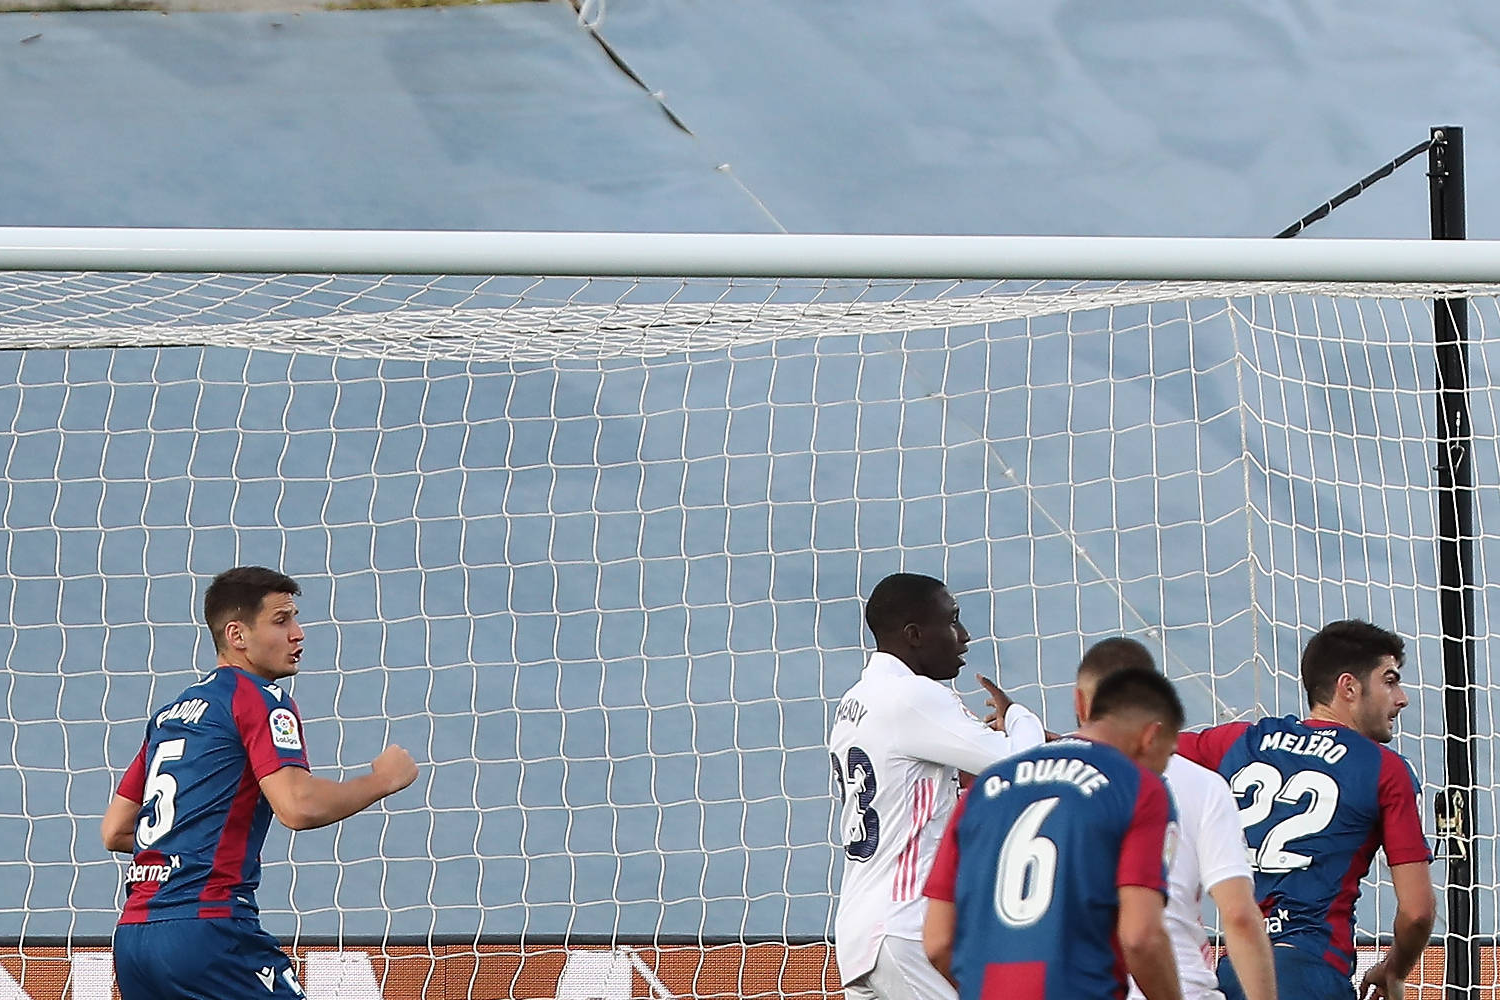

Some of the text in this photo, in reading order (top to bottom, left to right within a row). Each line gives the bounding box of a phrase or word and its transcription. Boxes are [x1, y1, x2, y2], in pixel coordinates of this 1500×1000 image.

[136, 738, 186, 850] 5
[1015, 758, 1110, 798] DUARTE
[1259, 731, 1348, 764] MELERO
[994, 796, 1061, 928] 6
[1229, 761, 1340, 873] 22
